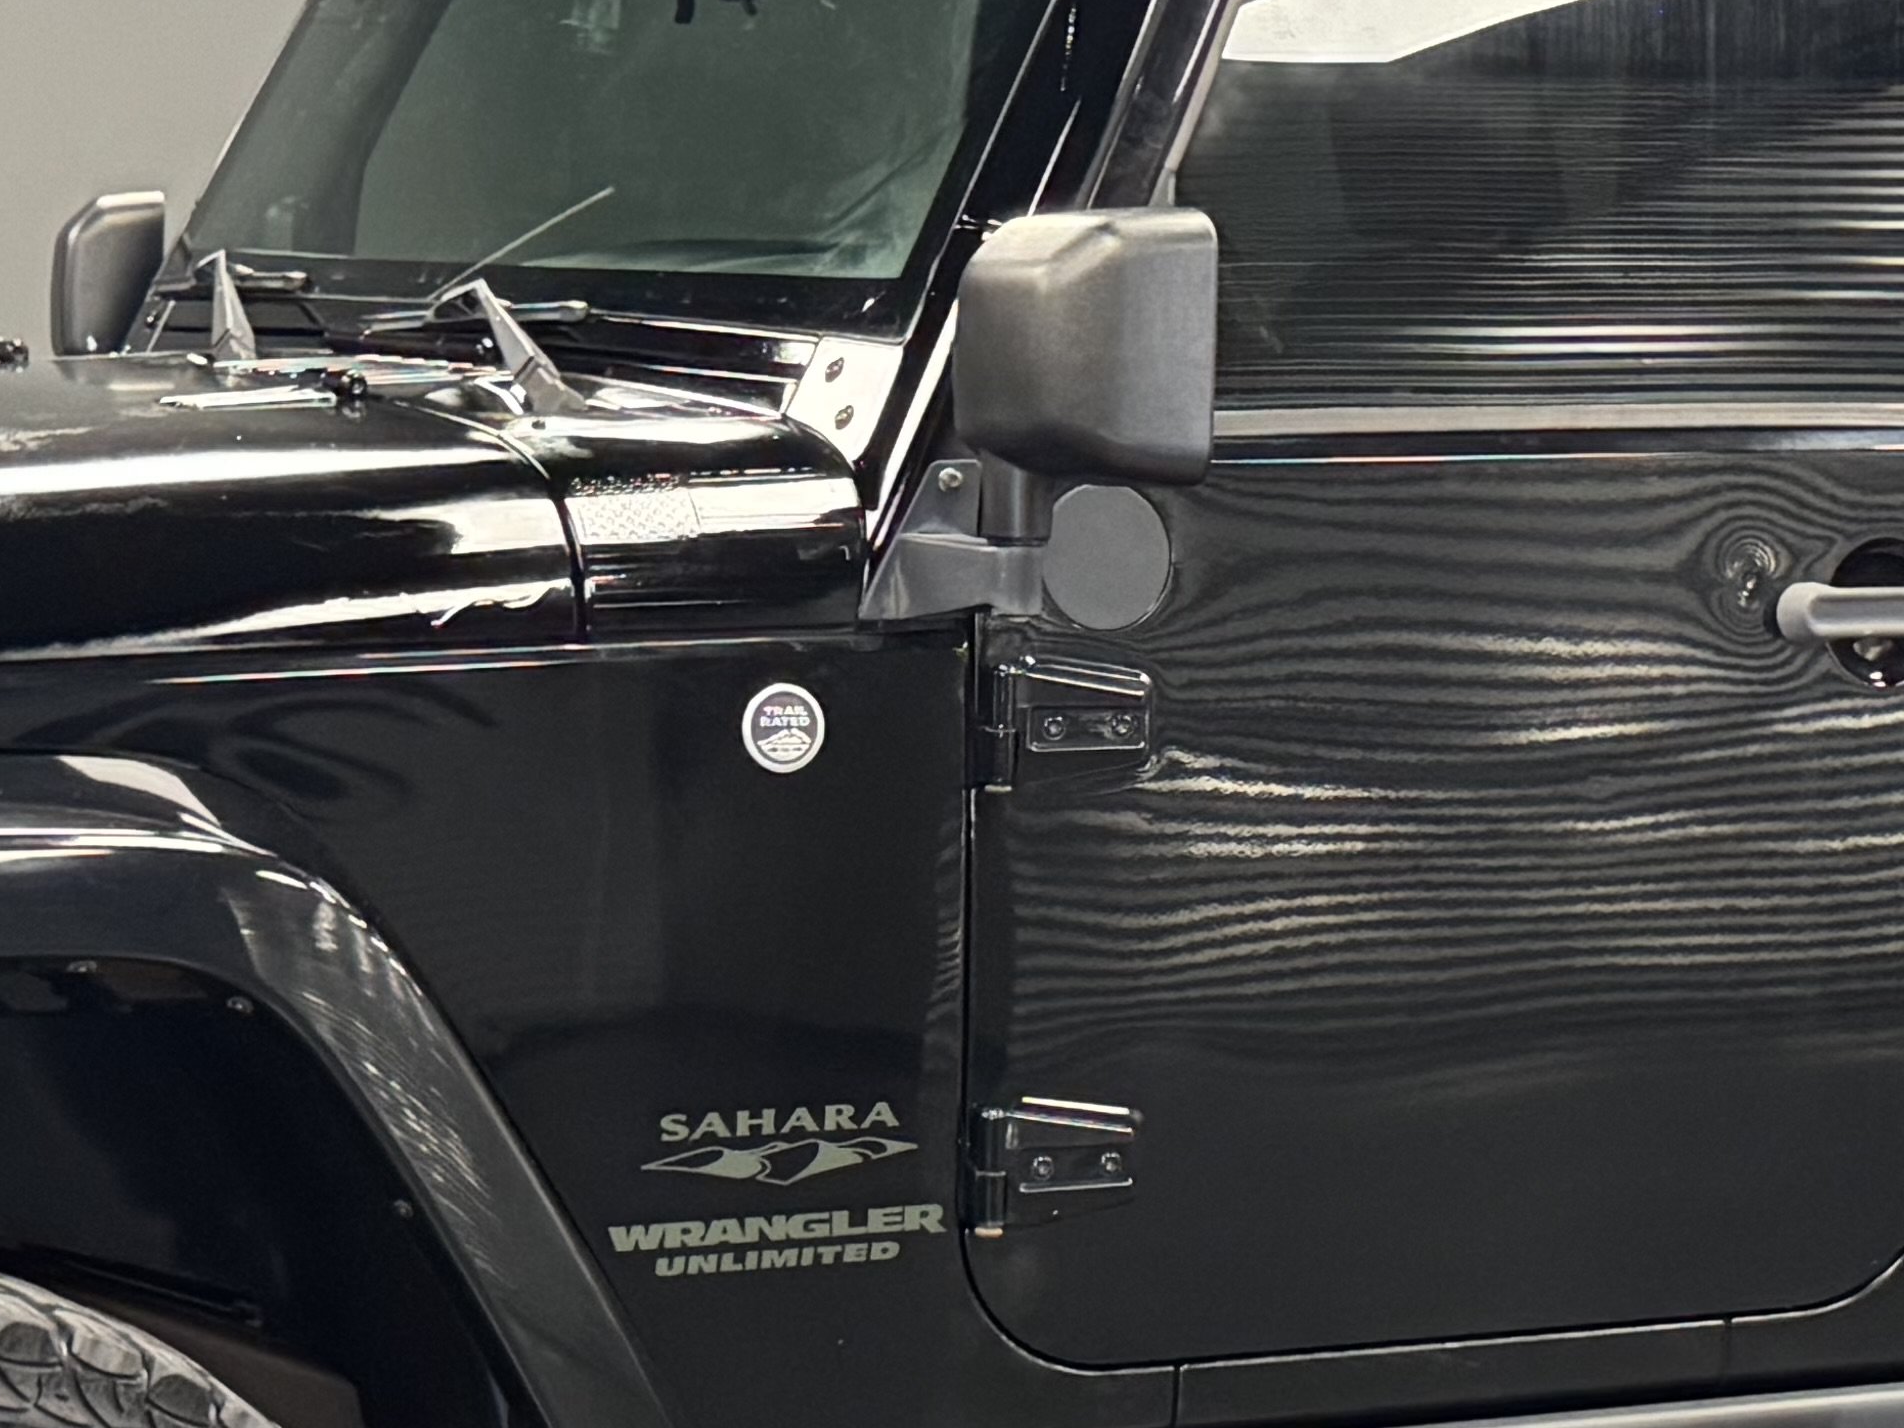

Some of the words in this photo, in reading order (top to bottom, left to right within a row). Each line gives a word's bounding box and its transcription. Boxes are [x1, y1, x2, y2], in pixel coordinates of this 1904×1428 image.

[759, 716, 811, 728] RATED
[659, 1100, 901, 1143] SAHARA
[606, 1202, 948, 1253] WRANGLER
[653, 1240, 901, 1278] UNLIMITED
